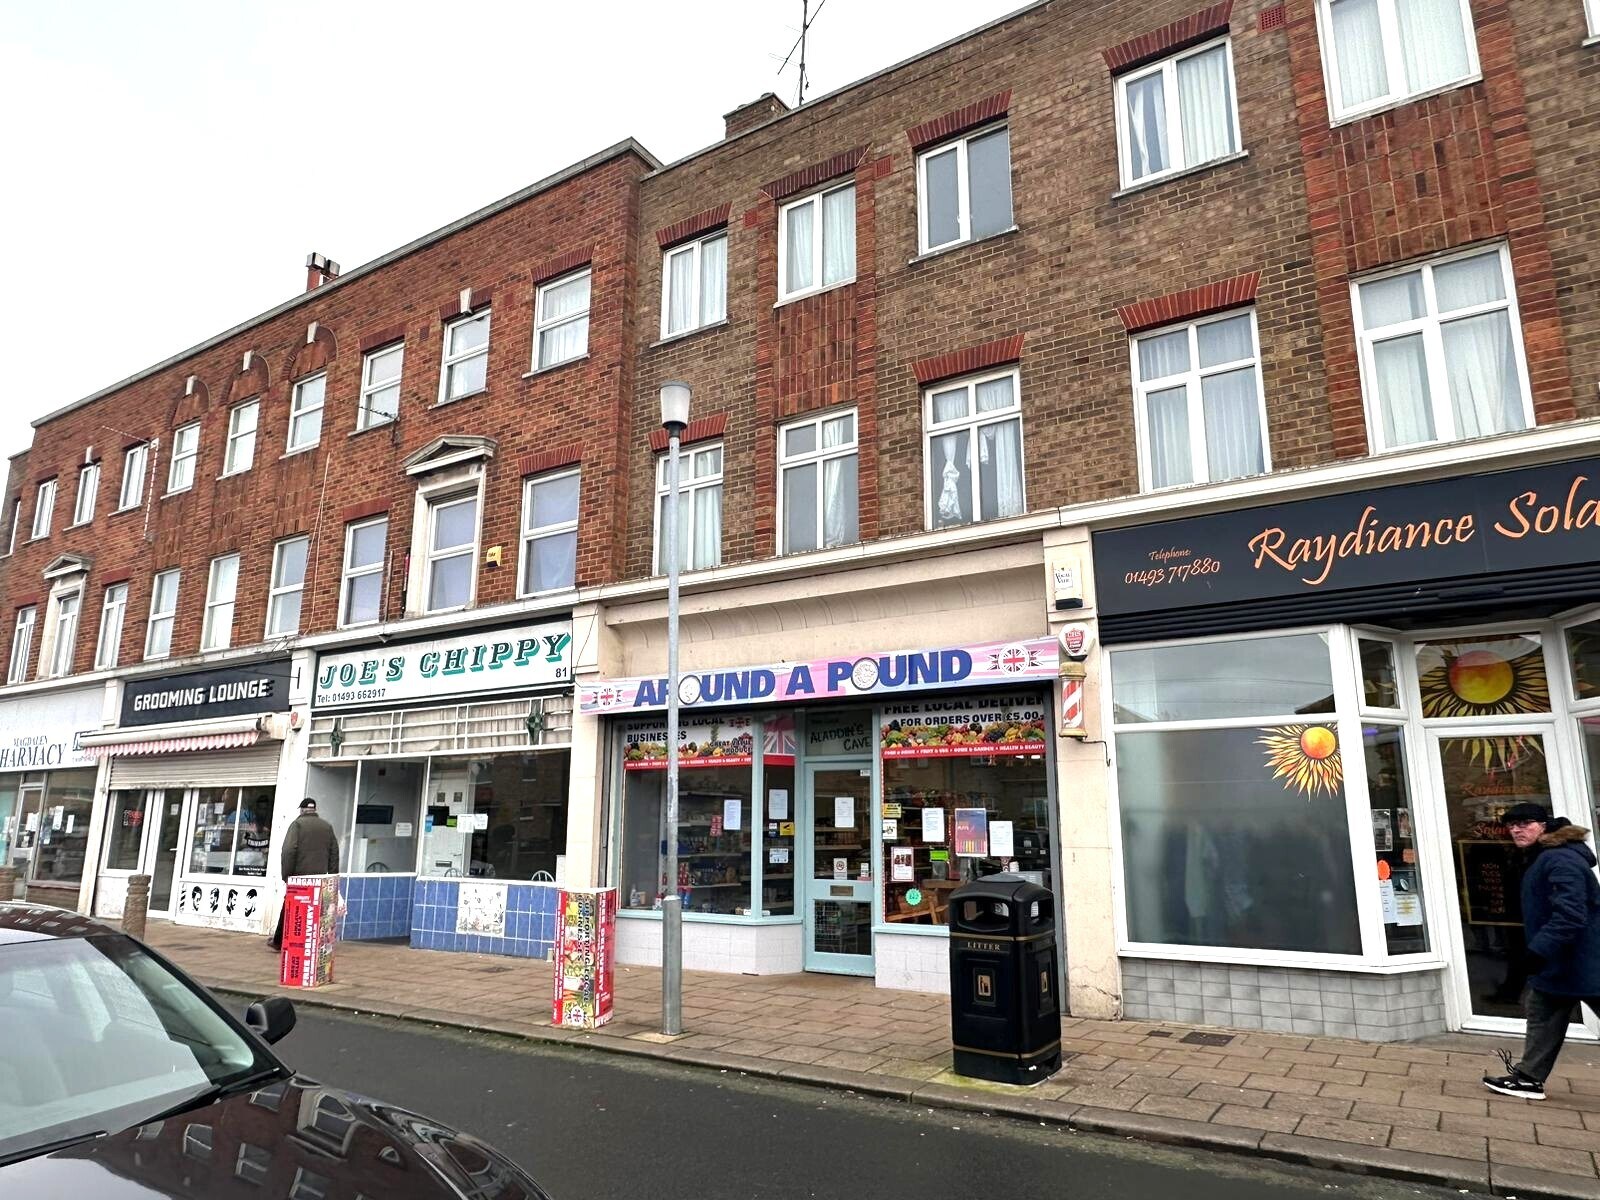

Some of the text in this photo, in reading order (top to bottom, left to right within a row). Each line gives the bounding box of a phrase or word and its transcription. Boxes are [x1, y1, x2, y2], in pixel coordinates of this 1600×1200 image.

[1247, 475, 1600, 586] Raydiance Sola
[1124, 557, 1221, 587] 01493 717880
[319, 632, 572, 689] JOE'S CHIPPY
[555, 667, 568, 678] 81
[785, 665, 815, 695] A
[828, 649, 973, 692] POUND
[134, 679, 272, 711] GROOMING LOUNGE
[317, 688, 387, 704] Tel: 01493 662917
[900, 718, 922, 727] FOR
[925, 714, 970, 726] ORDERS
[972, 713, 1002, 723] OVER
[626, 731, 687, 743] BUSINESES
[843, 736, 872, 751] CAVE
[304, 905, 314, 957] DELIVERY
[967, 941, 1000, 951] LITTER
[303, 959, 311, 987] FREE
